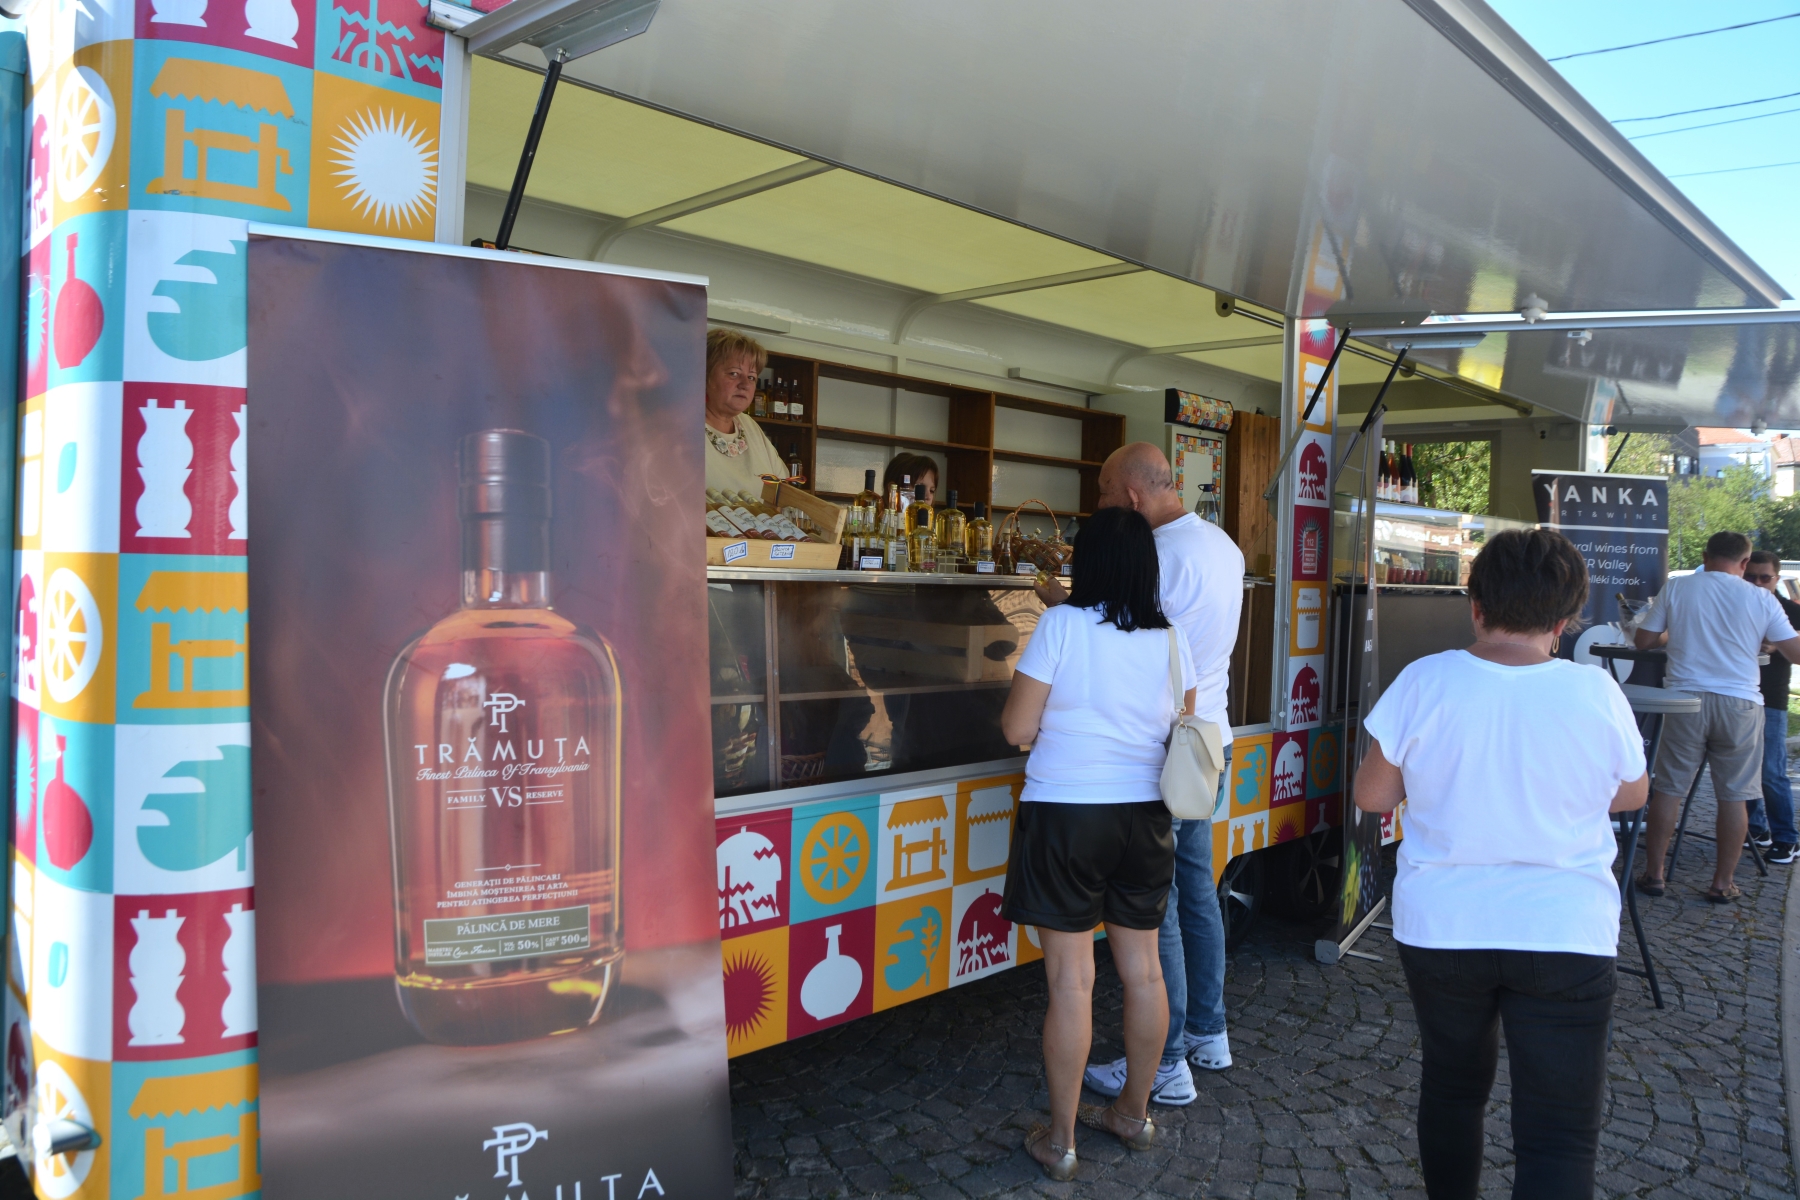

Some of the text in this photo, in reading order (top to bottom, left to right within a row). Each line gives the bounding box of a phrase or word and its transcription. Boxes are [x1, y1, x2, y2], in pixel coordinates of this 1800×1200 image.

[1544, 484, 1658, 506] YANKA
[1594, 543, 1627, 554] wines
[1629, 543, 1659, 556] from
[1597, 559, 1632, 573] Valley
[1612, 575, 1640, 586] borok
[447, 794, 486, 804] FAMILY
[489, 786, 523, 807] VS
[526, 789, 564, 799] RESERVE
[503, 877, 515, 885] DE
[546, 882, 569, 890] ARTA
[437, 900, 470, 908] PENTRU
[471, 896, 520, 906] ATINGEREA
[509, 920, 526, 930] DE
[528, 916, 560, 928] MERE
[517, 940, 539, 950] 50%
[561, 934, 580, 945] 500
